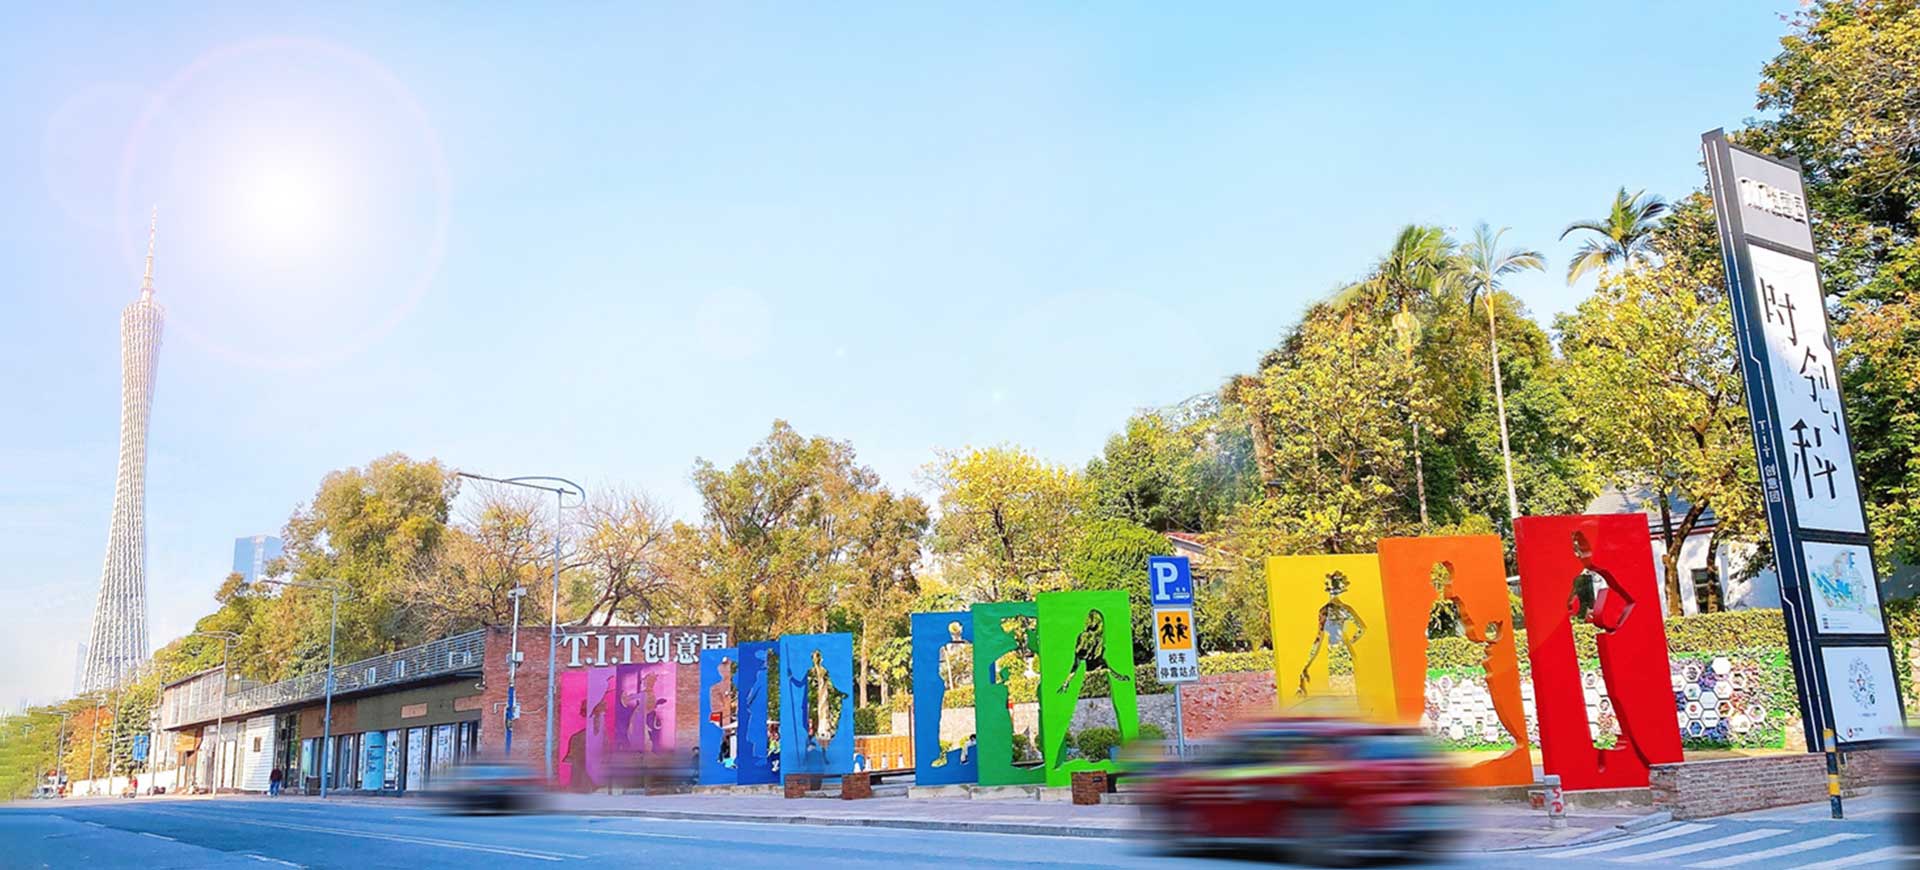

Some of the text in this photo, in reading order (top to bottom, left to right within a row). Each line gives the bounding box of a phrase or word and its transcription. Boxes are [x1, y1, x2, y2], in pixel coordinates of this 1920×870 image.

[1153, 562, 1178, 600] P
[1169, 652, 1186, 664] 校车
[1160, 665, 1197, 679] 停靠站点
